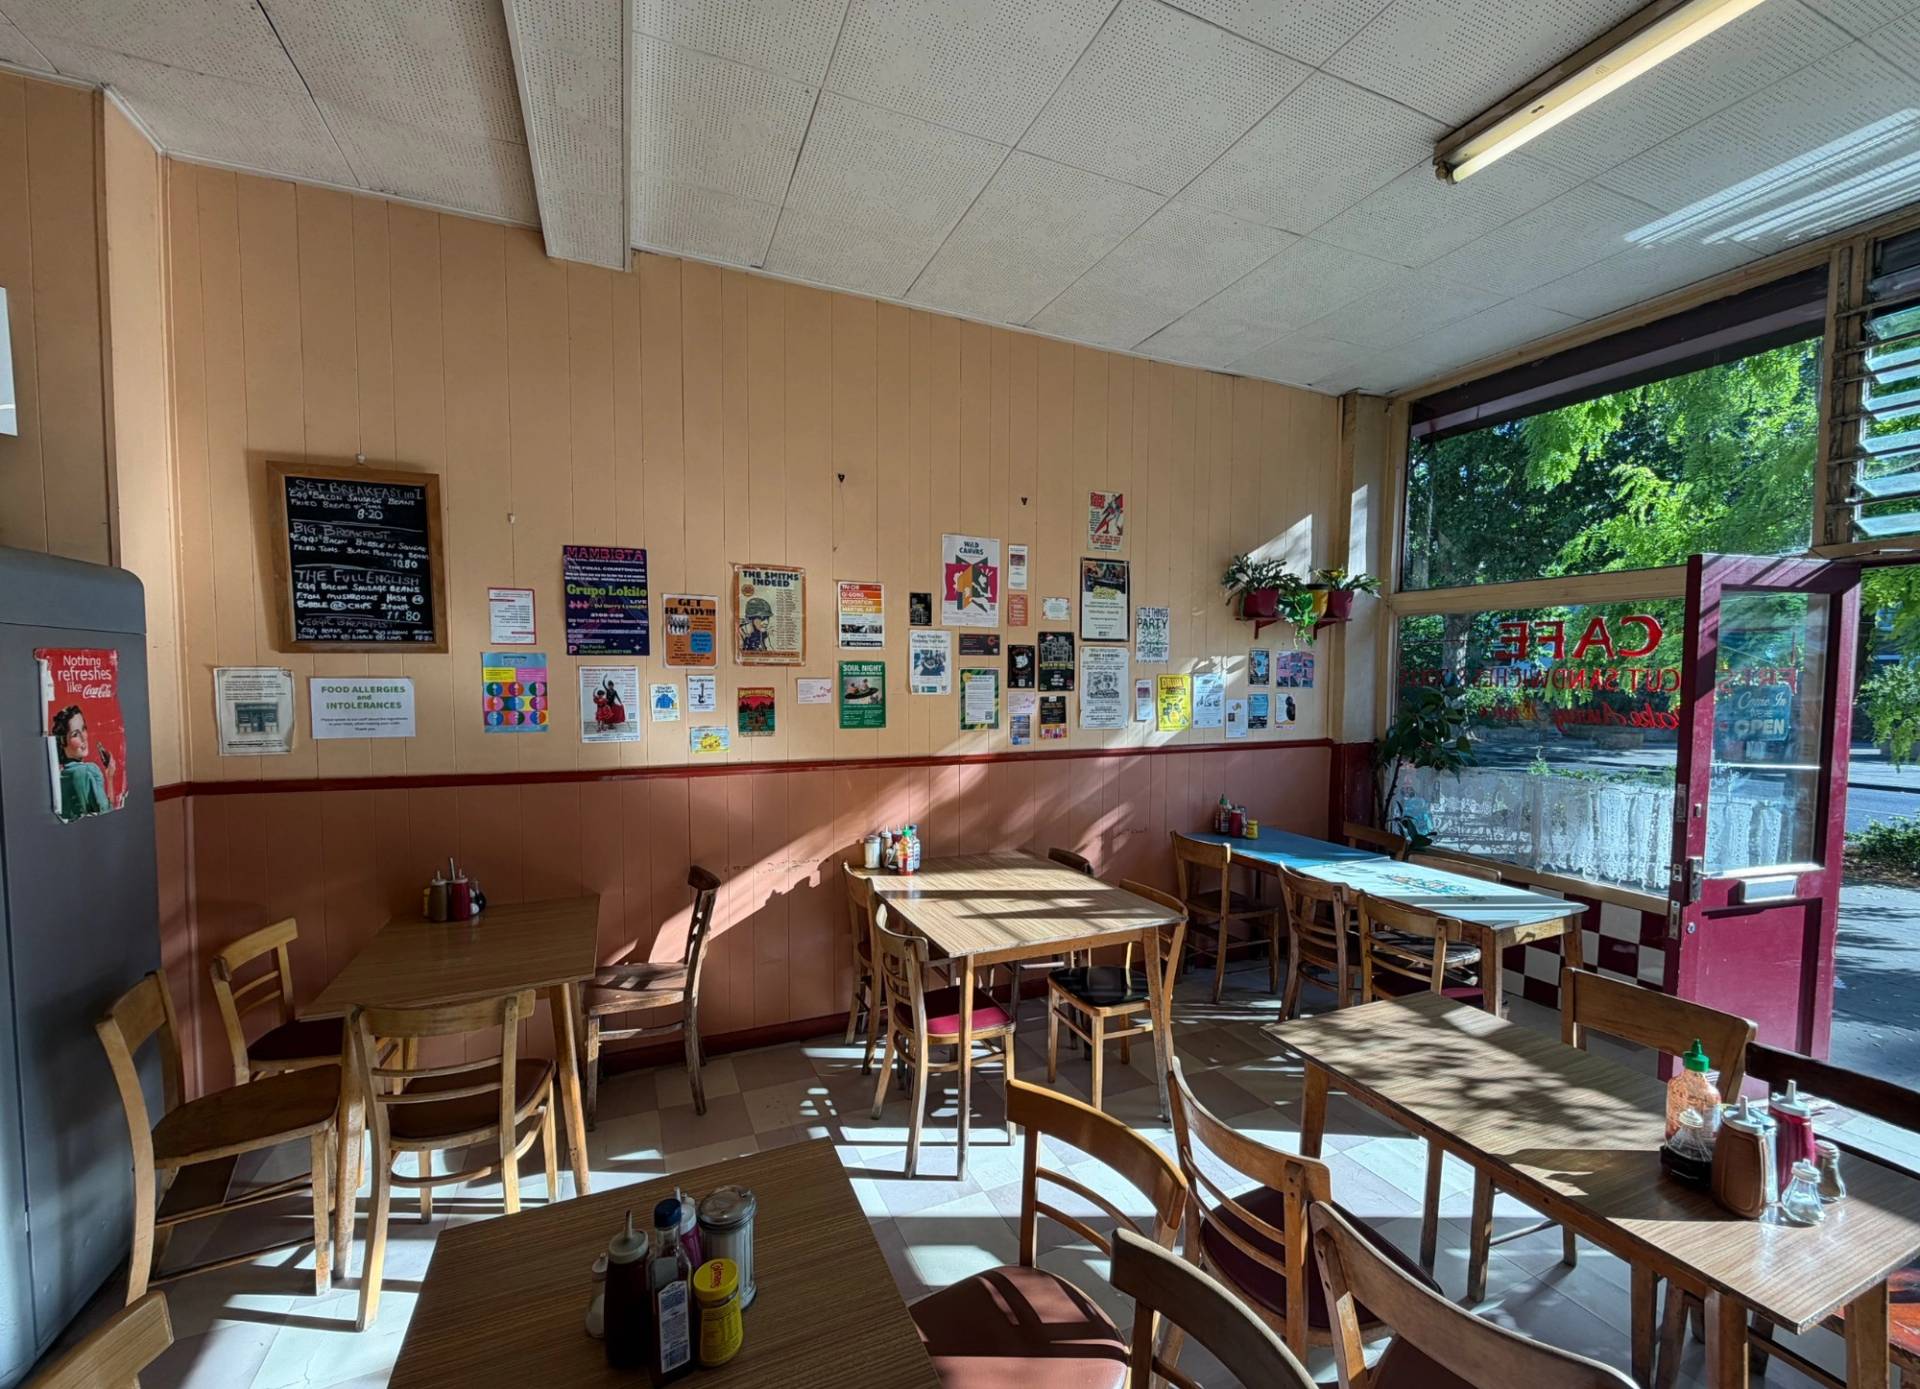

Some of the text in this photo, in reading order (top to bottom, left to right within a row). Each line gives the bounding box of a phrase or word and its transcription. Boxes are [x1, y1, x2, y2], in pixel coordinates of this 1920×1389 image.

[329, 482, 400, 499] BREAKFAST
[293, 521, 316, 534] BIG
[294, 568, 420, 587] THE FULL ENGLISH
[742, 570, 799, 581] THE SMITHS
[753, 579, 790, 587] INDEED
[567, 583, 606, 598] Grupo
[678, 598, 702, 607] GET
[1137, 618, 1169, 630] PARTY
[63, 655, 101, 667] Nothing
[57, 667, 112, 681] refreshes
[842, 664, 860, 672] SOUL
[67, 682, 82, 693] like
[321, 685, 406, 694] FOOD ALLERGIES
[326, 702, 402, 710] INTOLERANCES
[1734, 718, 1785, 736] OPEN
